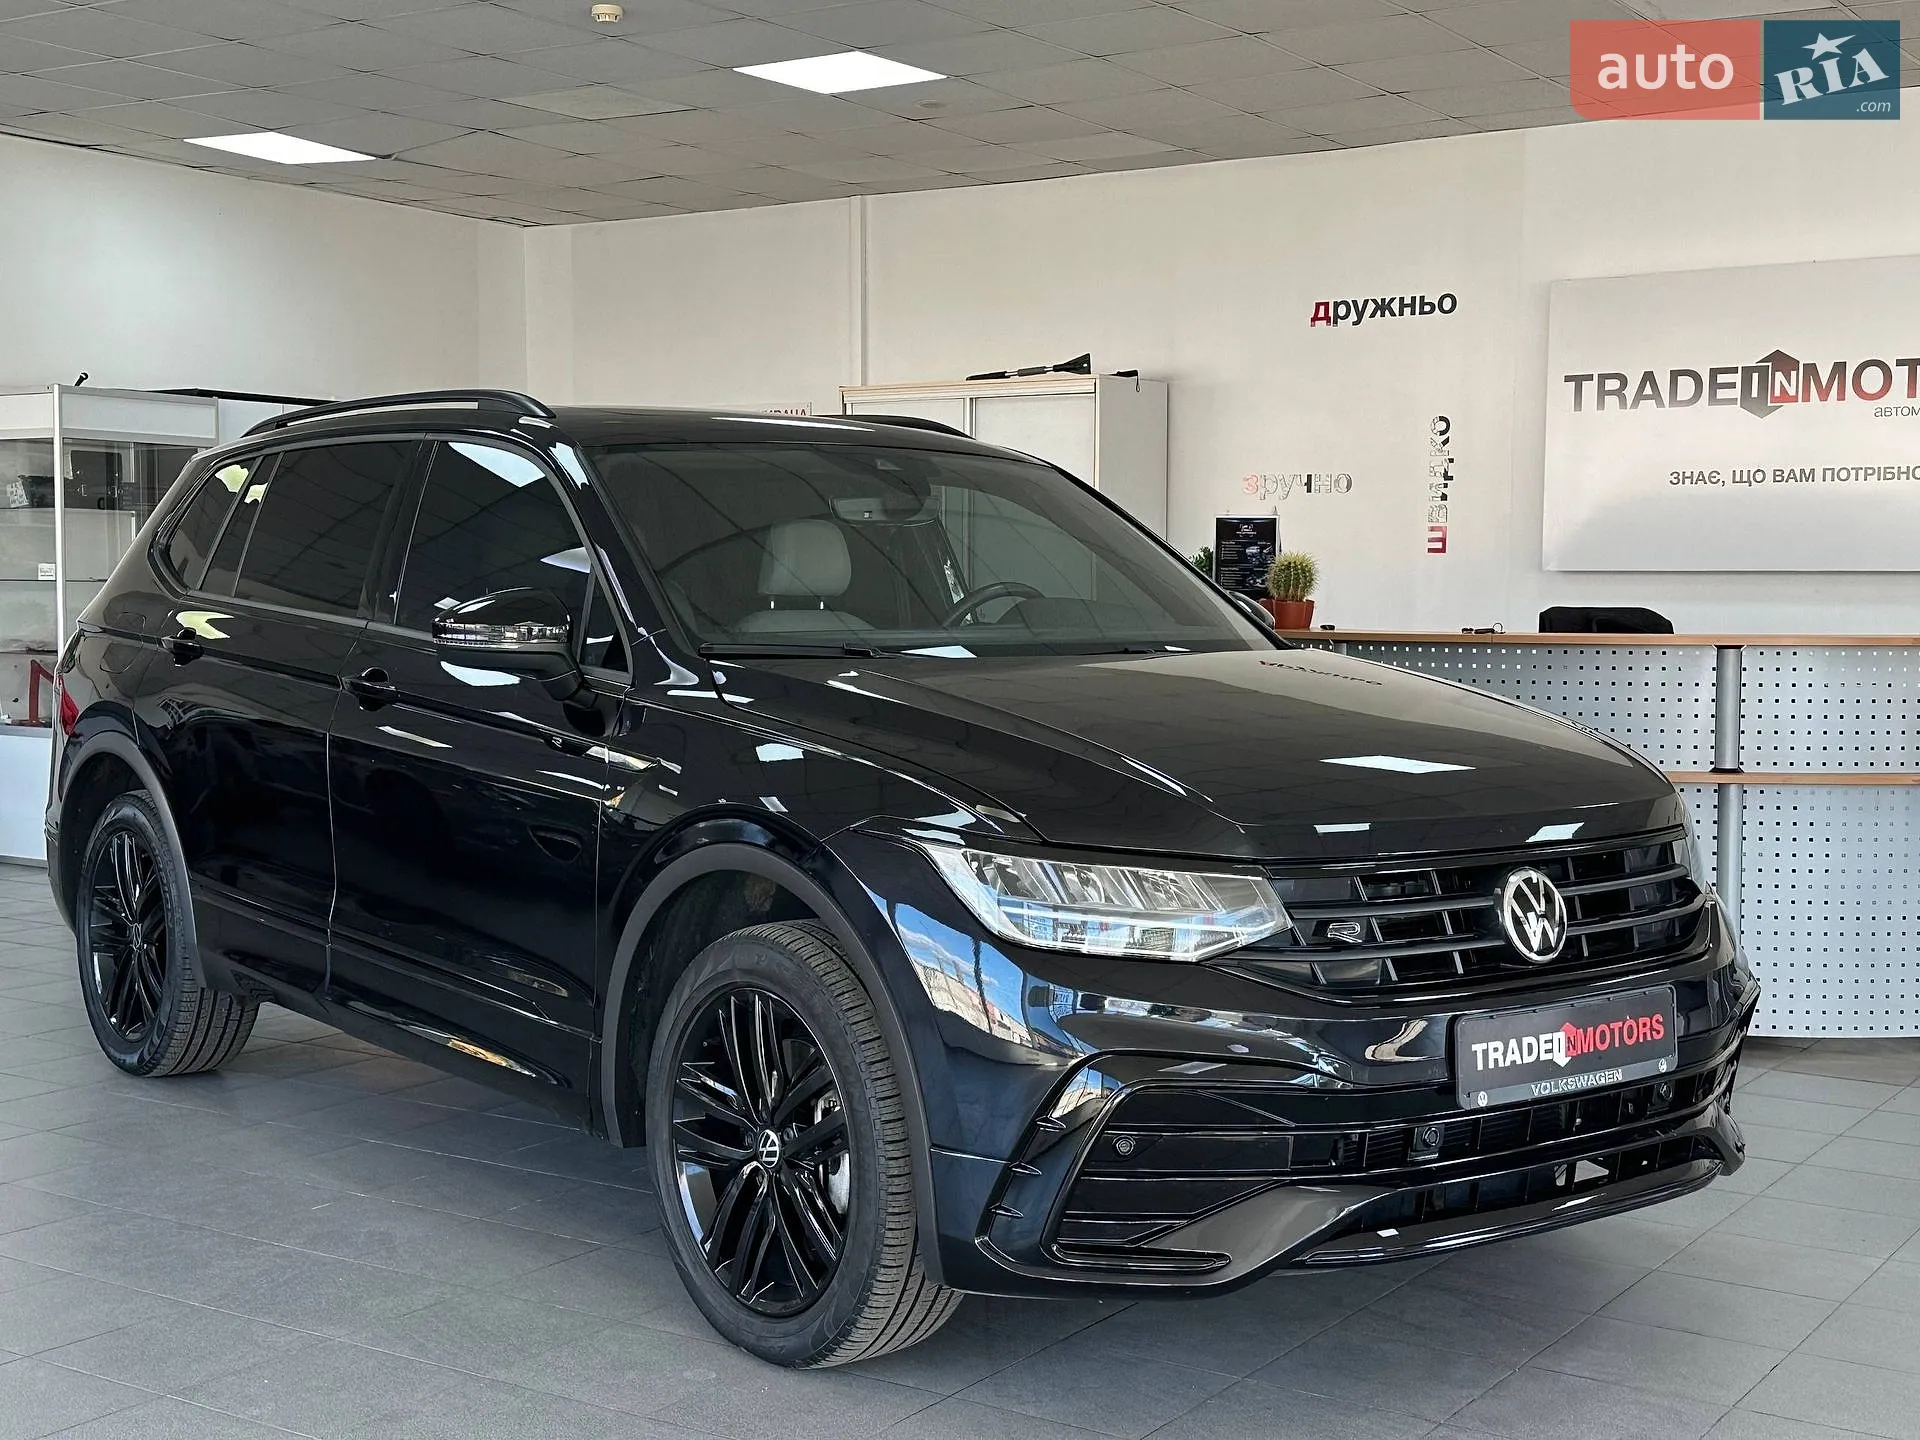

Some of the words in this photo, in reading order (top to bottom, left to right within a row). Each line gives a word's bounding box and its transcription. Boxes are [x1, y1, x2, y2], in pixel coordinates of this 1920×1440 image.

[1310, 292, 1458, 328] дружньо
[1242, 472, 1353, 501] зручно
[1668, 469, 1727, 488] ЗНАЄ,
[1731, 467, 1767, 487] ЩО
[1772, 466, 1816, 484] ВАМ
[1530, 1067, 1624, 1097] VOLKSWAGEN
